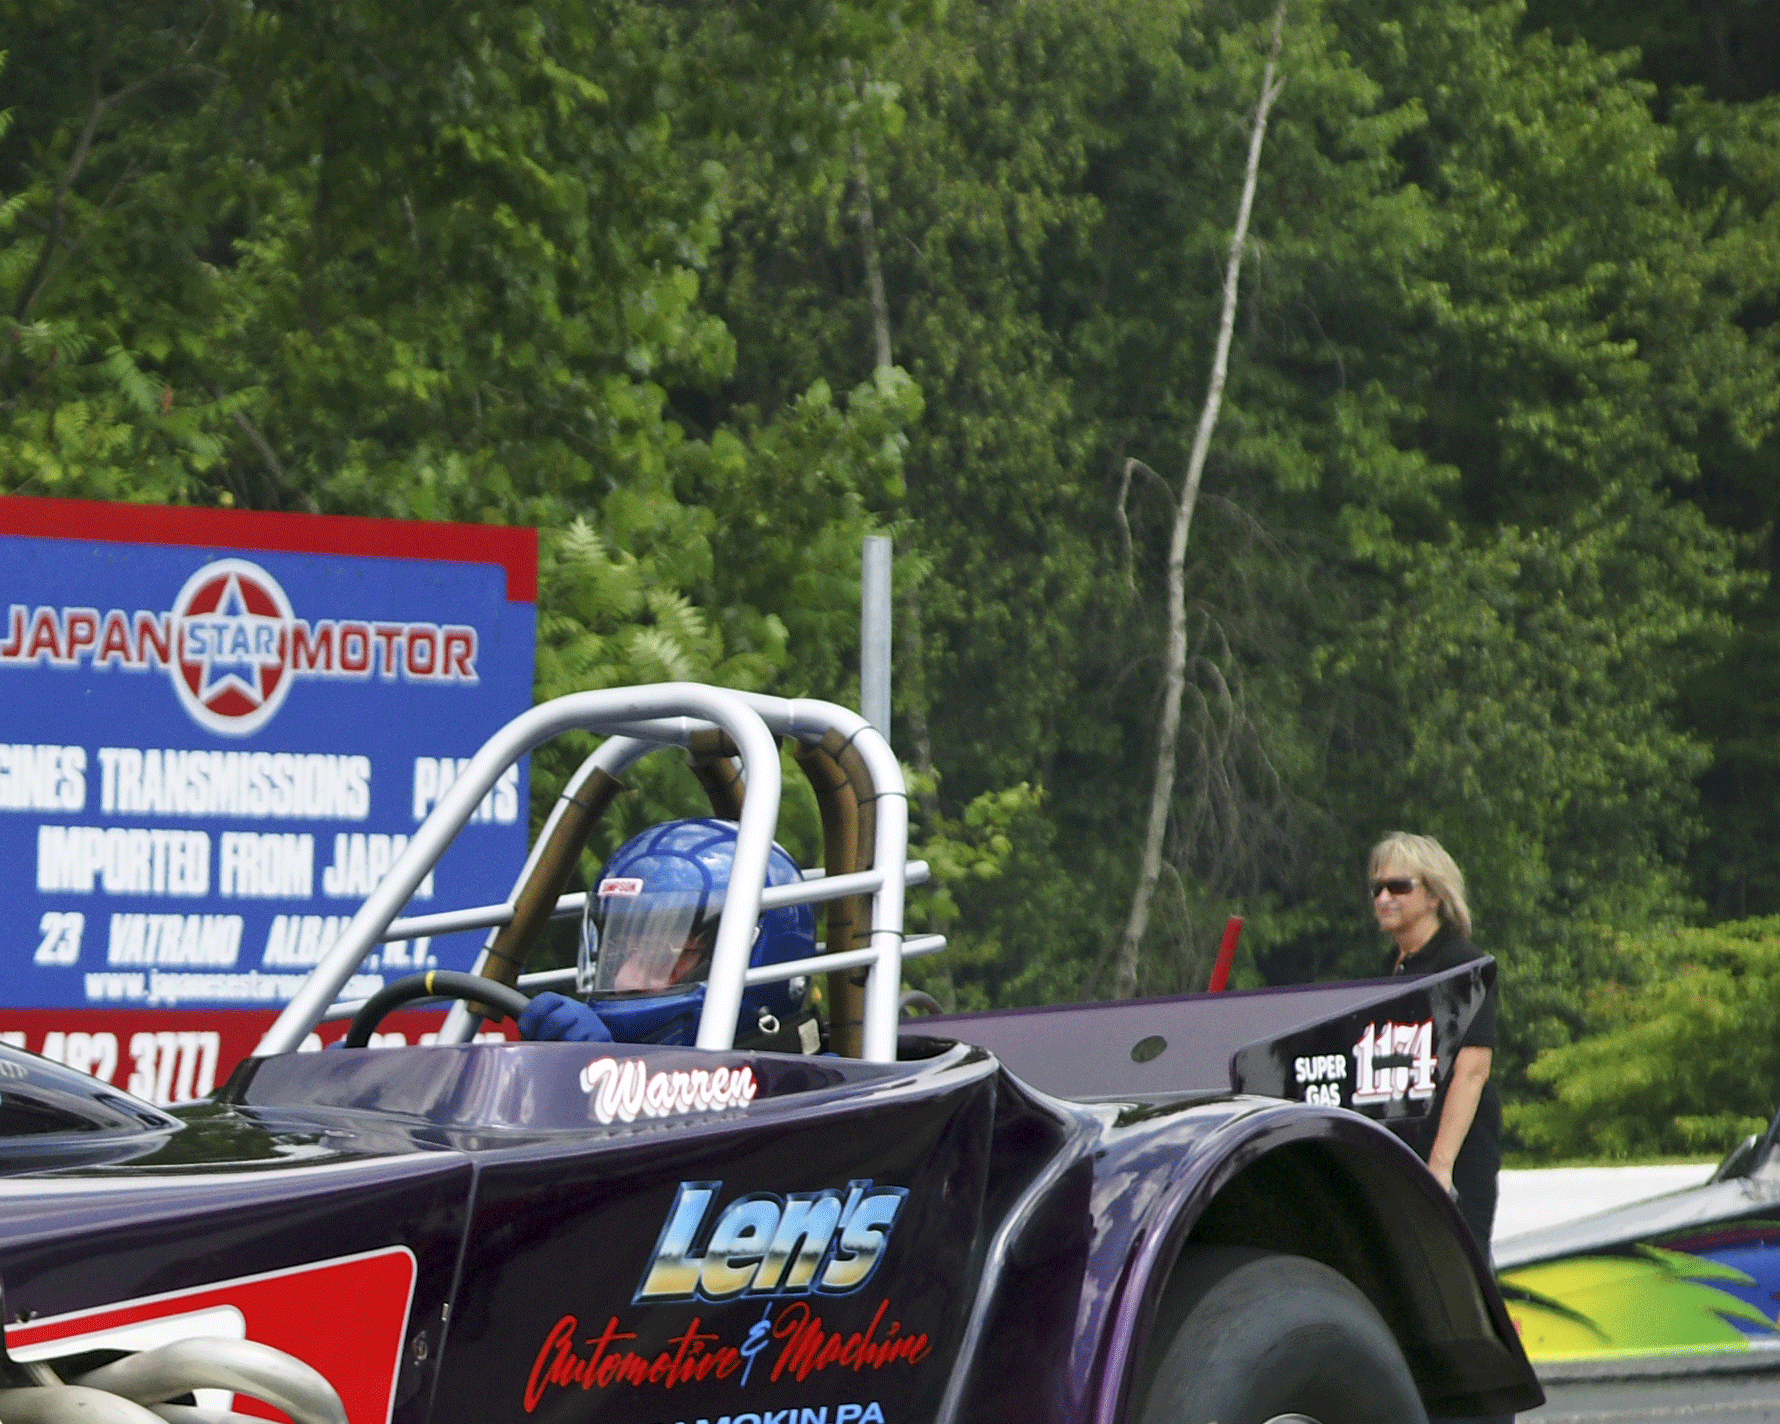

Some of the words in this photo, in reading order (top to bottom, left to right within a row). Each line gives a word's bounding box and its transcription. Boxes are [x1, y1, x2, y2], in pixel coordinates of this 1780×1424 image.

[188, 622, 278, 656] STAR
[290, 620, 479, 682] MOTOR
[98, 748, 371, 819] TRANSMISSIONS
[36, 826, 210, 894] IMPORTED
[220, 832, 314, 898] FROM
[34, 912, 85, 966] 23
[127, 1031, 220, 1104] 3777
[580, 1057, 758, 1124] Warren
[1295, 1055, 1347, 1083] SUPER
[1305, 1083, 1342, 1107] GAS
[631, 1178, 910, 1306] Len's
[524, 1315, 742, 1413] Automotive
[740, 1302, 772, 1387] &
[769, 1299, 933, 1382] Machine
